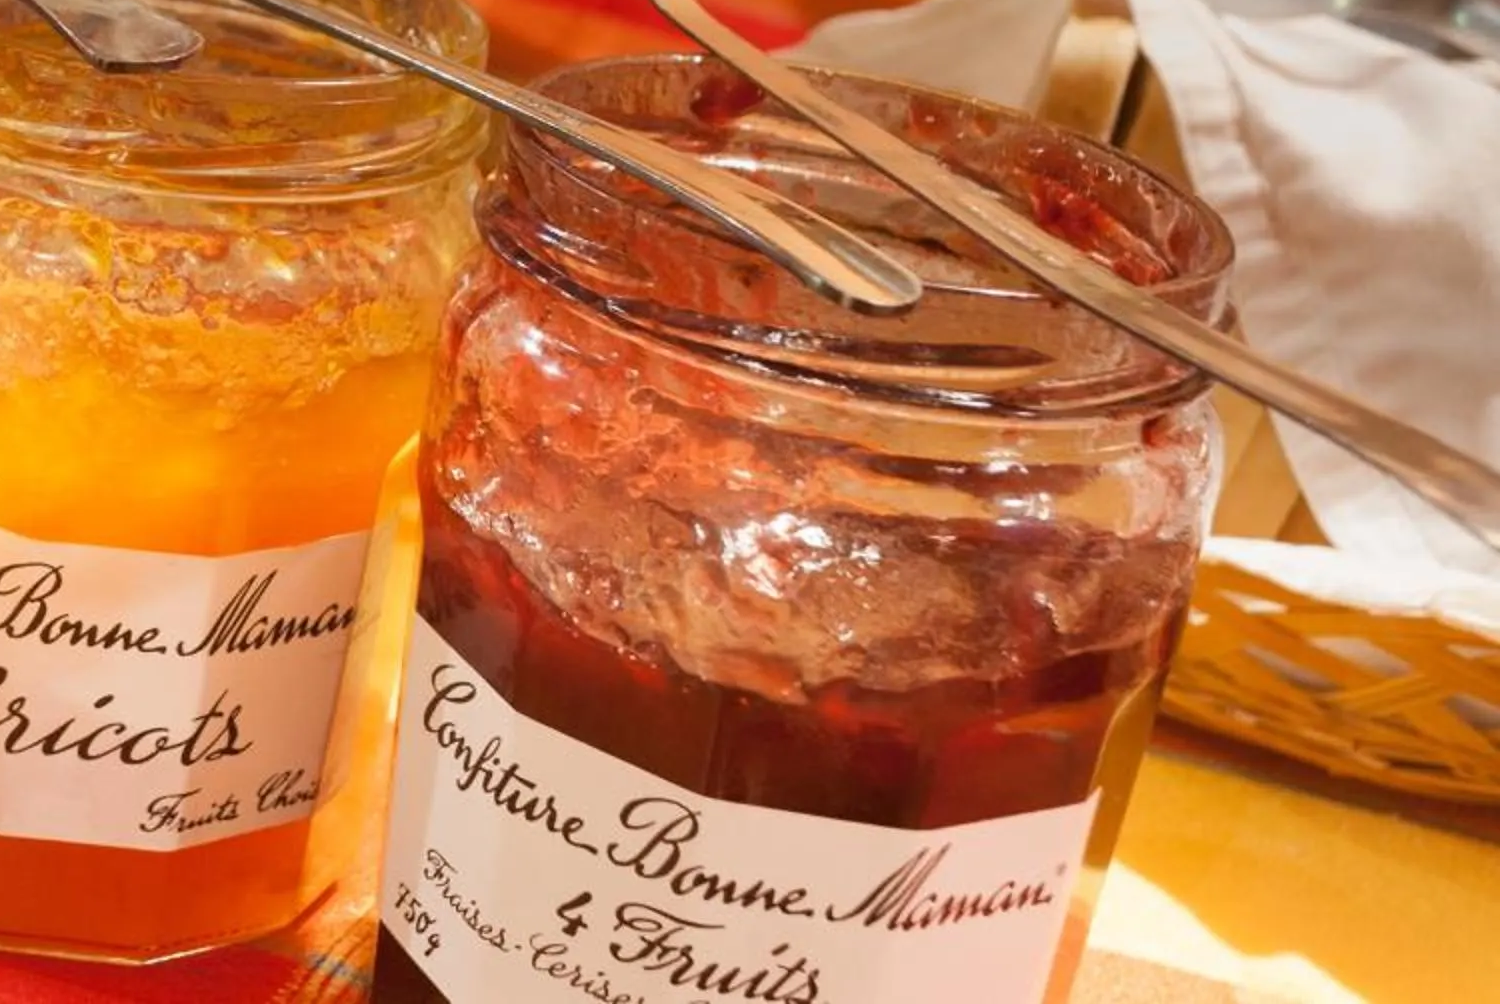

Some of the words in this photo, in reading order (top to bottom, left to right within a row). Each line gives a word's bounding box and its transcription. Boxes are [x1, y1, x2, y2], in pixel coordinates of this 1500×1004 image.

[138, 791, 240, 834] Fruits
[422, 663, 599, 855] Confiture
[605, 796, 816, 918] Bonne
[529, 933, 646, 1004] Cerise
[555, 890, 595, 938] 4
[608, 901, 822, 1004] Fruits
